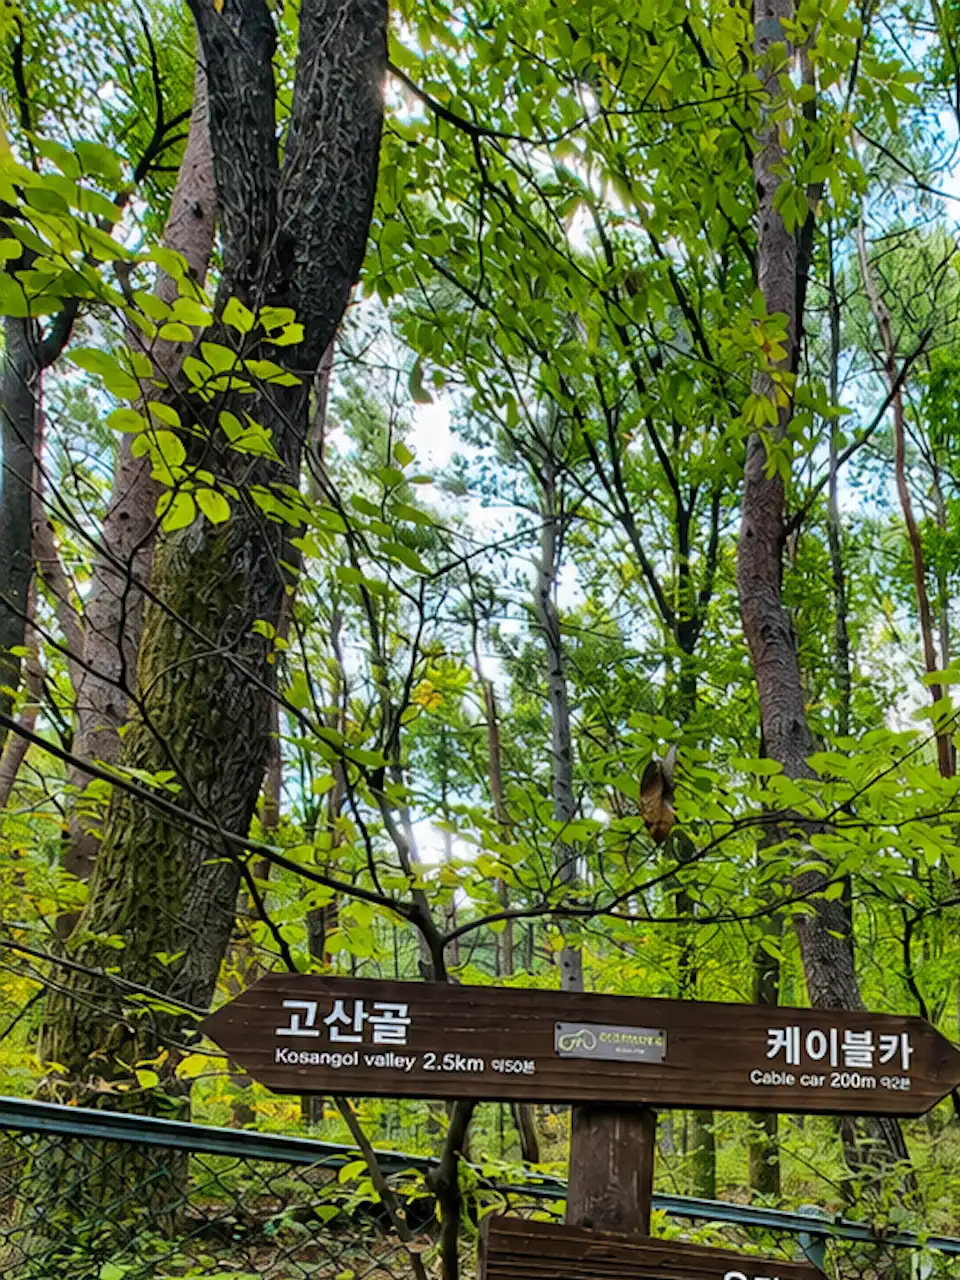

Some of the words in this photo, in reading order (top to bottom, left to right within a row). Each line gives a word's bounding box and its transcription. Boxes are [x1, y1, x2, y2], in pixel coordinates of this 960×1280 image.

[275, 999, 412, 1046] 고산골
[274, 1047, 359, 1069] Kosangol
[364, 1052, 417, 1072] valley
[422, 1052, 484, 1073] 2.5km
[766, 1026, 914, 1071] 케이블카
[750, 1069, 796, 1086] Cable
[800, 1074, 826, 1087] car
[830, 1072, 877, 1089] 200m
